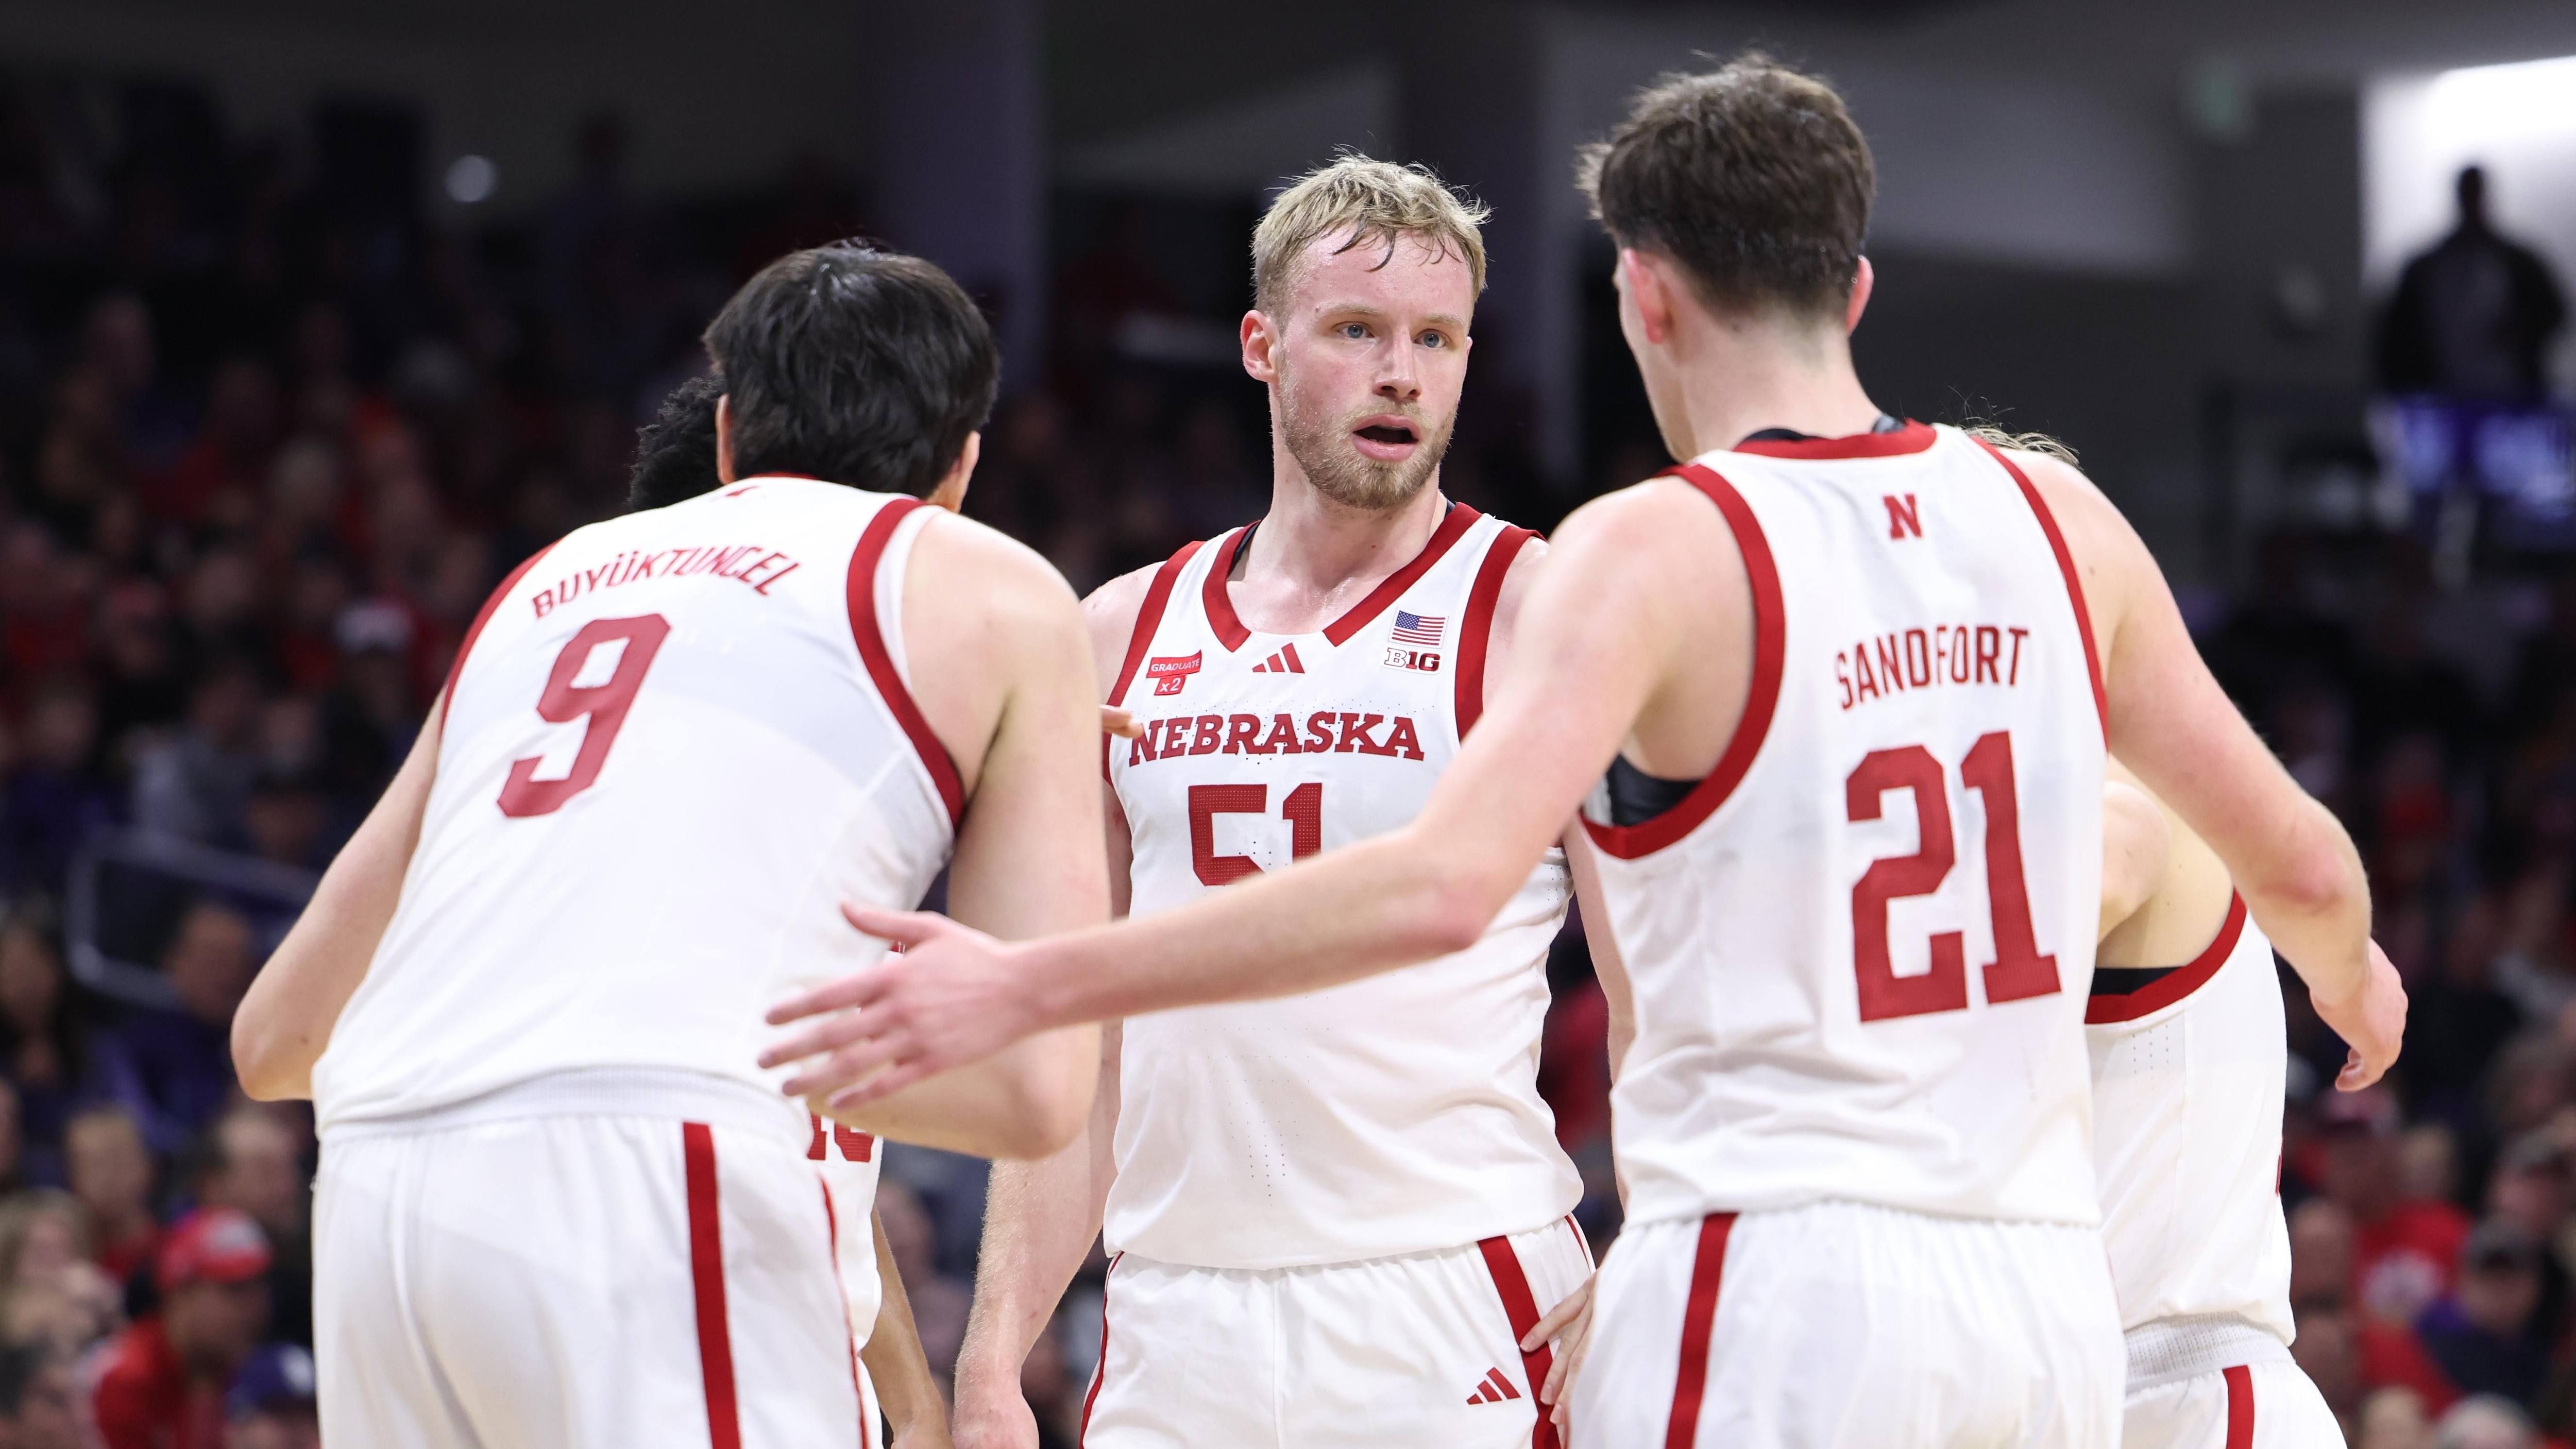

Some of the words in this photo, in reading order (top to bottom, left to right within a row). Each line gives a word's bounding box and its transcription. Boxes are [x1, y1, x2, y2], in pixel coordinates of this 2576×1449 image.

[1883, 493, 1922, 539] N
[1151, 658, 1200, 672] GRADUATE
[1159, 677, 1181, 692] x2
[1836, 624, 2029, 711] SANDFORT
[497, 613, 671, 818] 9
[1129, 711, 1425, 766] NEBRASKA
[1188, 783, 1322, 886] 51
[1846, 730, 2062, 1022] 21
